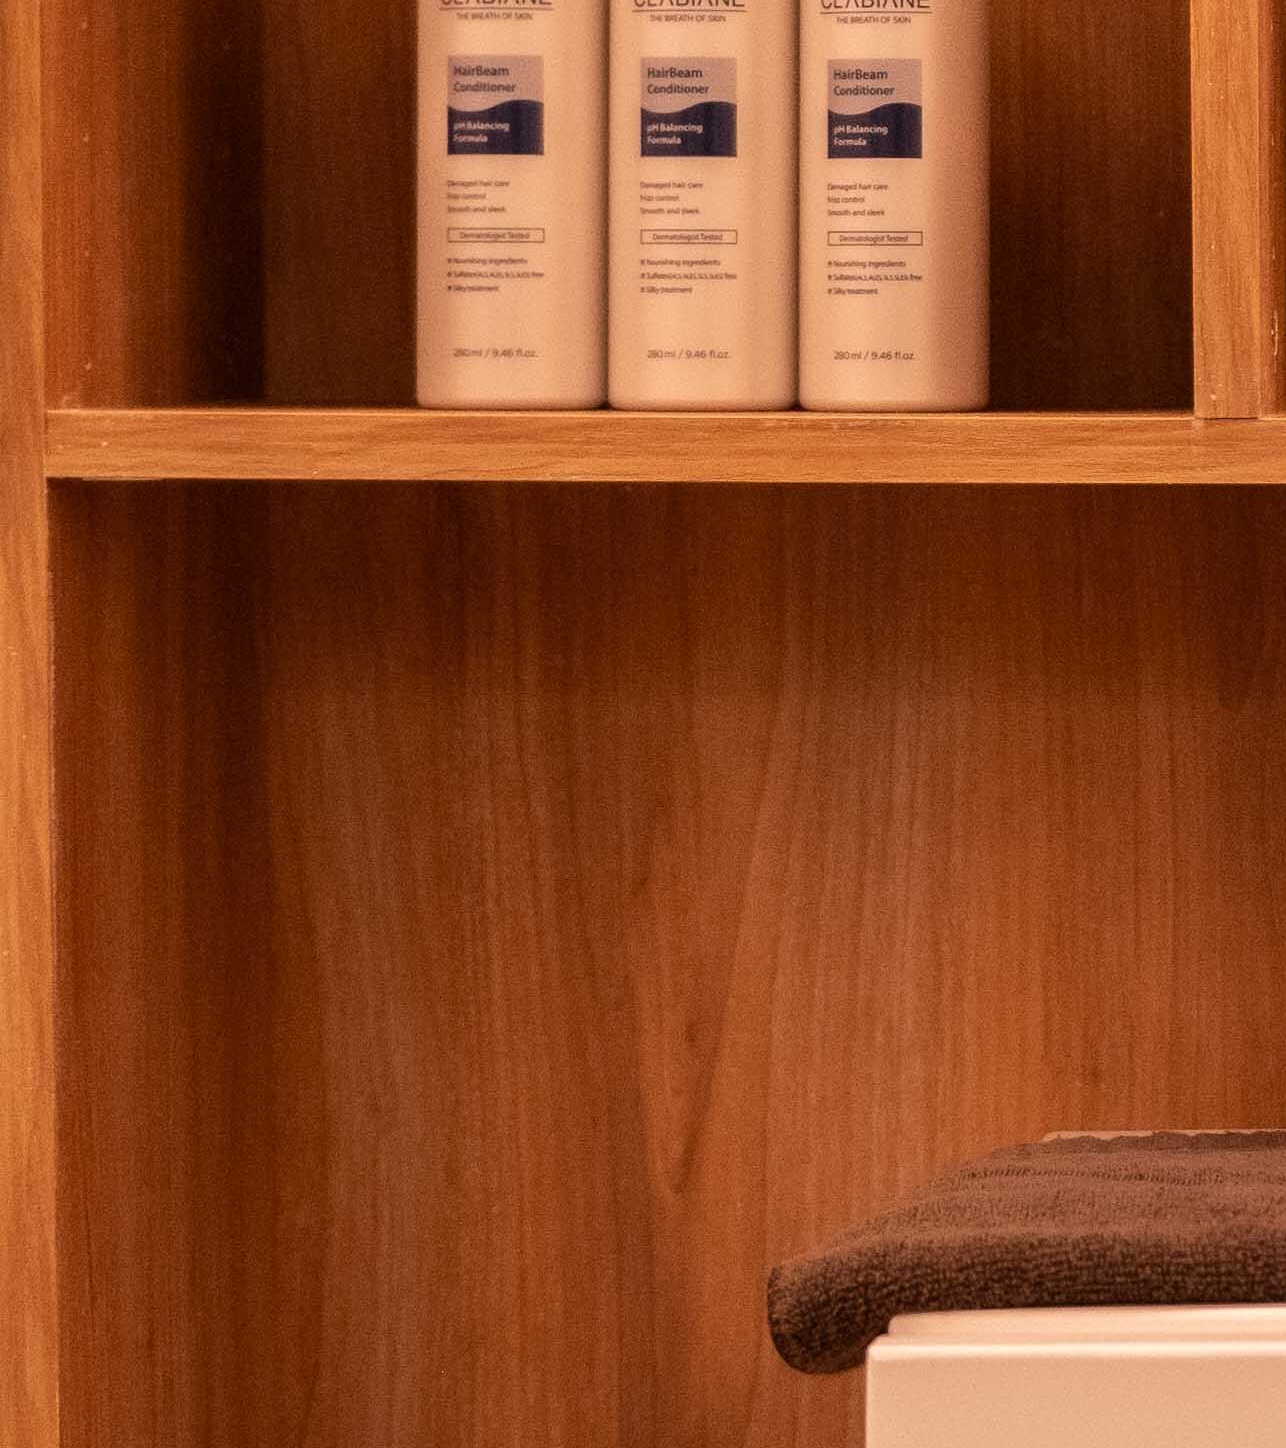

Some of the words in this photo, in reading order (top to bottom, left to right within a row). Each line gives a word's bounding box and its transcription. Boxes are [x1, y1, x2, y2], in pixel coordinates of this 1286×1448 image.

[452, 65, 510, 77] HairBeam
[647, 66, 703, 79] HairBeam
[833, 68, 889, 81] HairBeam
[452, 81, 517, 93] Conditioner
[646, 83, 710, 95] Conditioner
[832, 84, 895, 97] Conditioner
[453, 122, 467, 131] pH
[465, 120, 510, 133] Balancing
[646, 123, 659, 134] pH
[659, 122, 704, 134] Balancing
[833, 125, 846, 135] pH
[846, 124, 889, 136] Balancing
[453, 133, 488, 143] Formula
[646, 135, 682, 145] Formula
[833, 137, 867, 146] Formula
